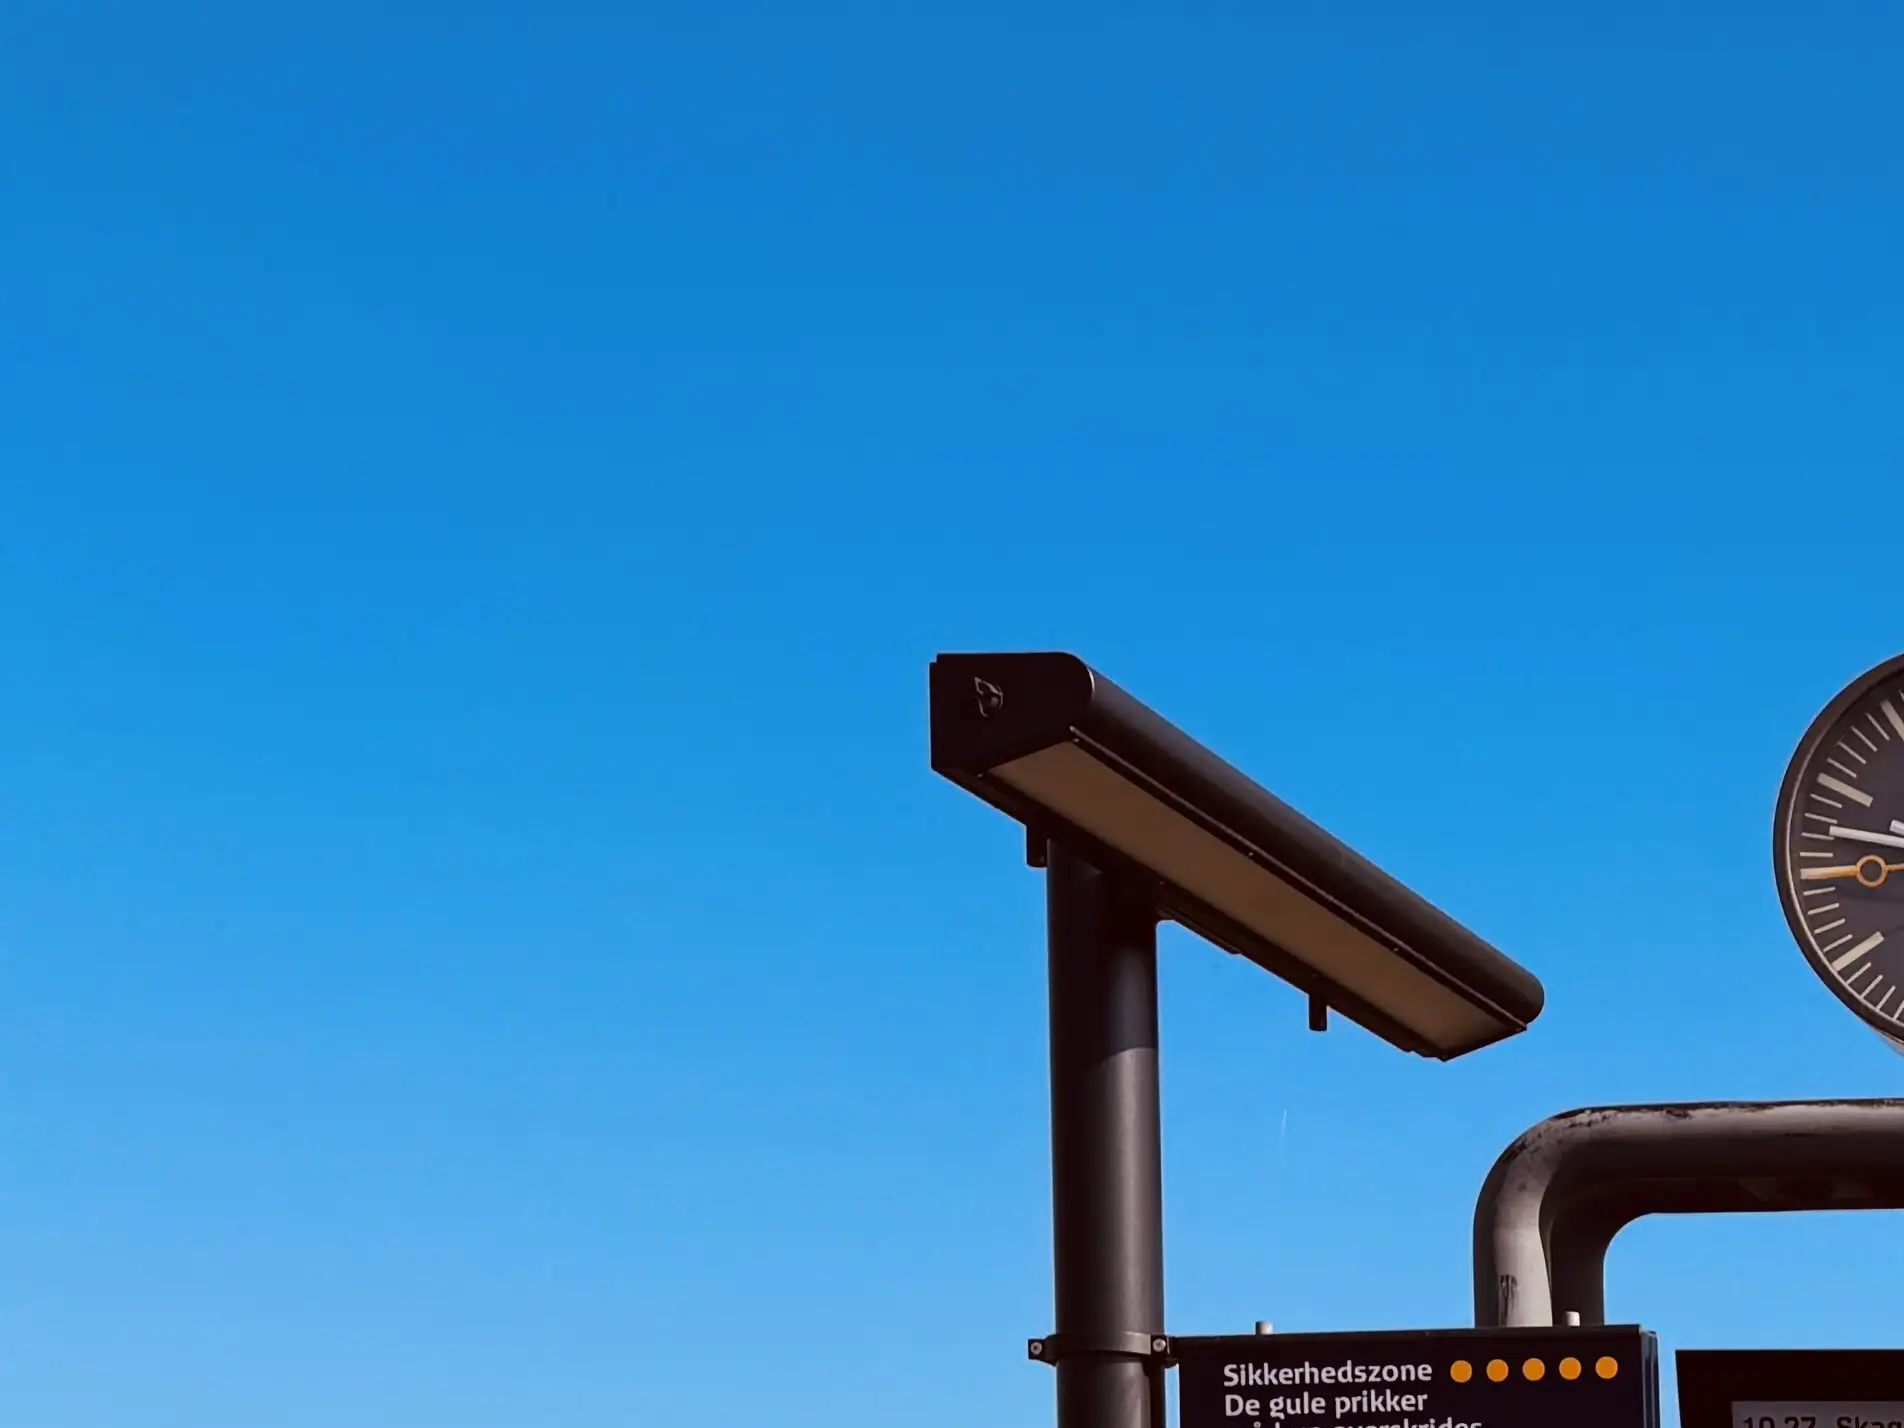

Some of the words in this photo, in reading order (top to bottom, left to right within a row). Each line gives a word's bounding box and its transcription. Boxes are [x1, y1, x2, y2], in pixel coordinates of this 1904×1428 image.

[1223, 1359, 1433, 1387] Sikkerhedszone
[1225, 1394, 1261, 1417] De
[1269, 1391, 1326, 1420] gule
[1334, 1388, 1428, 1419] prikker
